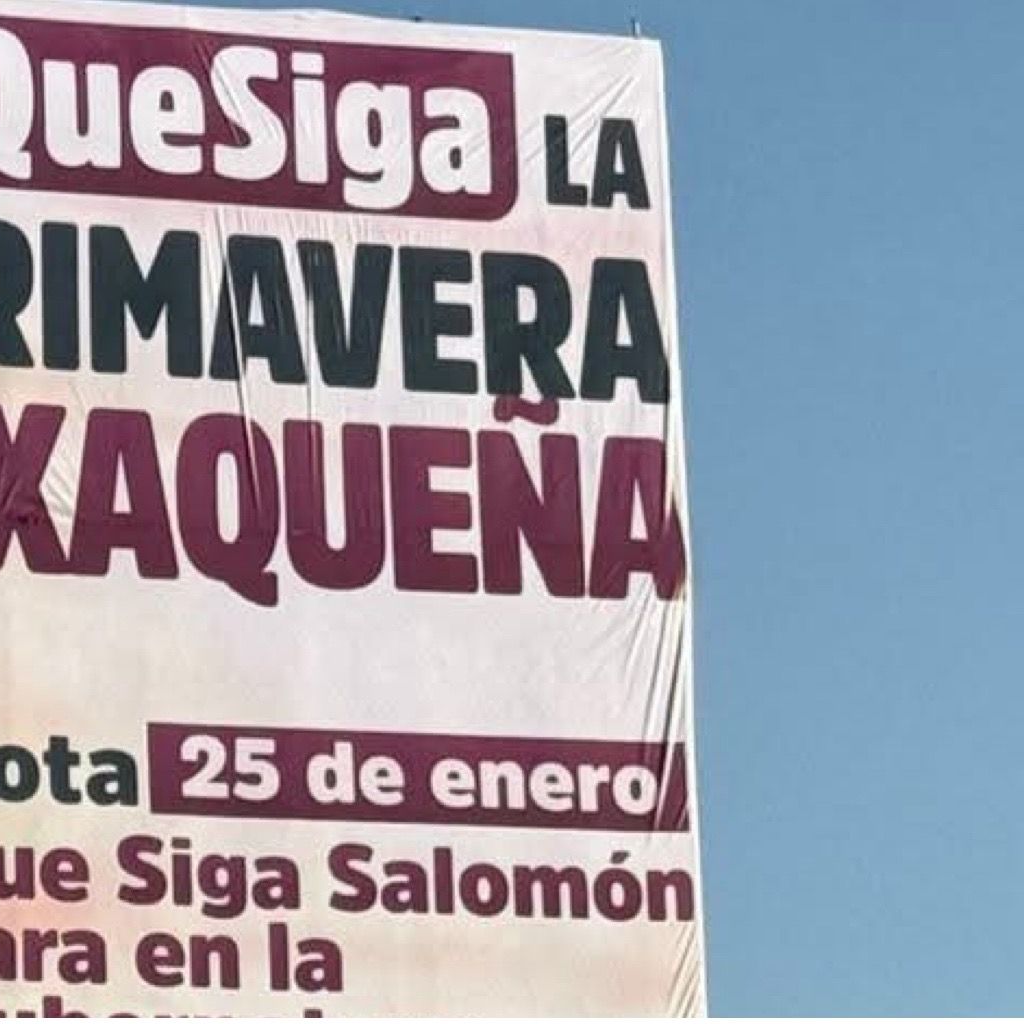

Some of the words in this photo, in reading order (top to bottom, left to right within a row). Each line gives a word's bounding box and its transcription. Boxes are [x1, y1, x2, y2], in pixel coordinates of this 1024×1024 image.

[545, 114, 651, 209] LA
[180, 735, 281, 801] 25
[306, 740, 406, 807] de
[431, 758, 662, 816] enero
[116, 835, 301, 919] Siga
[328, 843, 695, 922] Salomón
[134, 932, 241, 990] en
[268, 922, 344, 992] la
